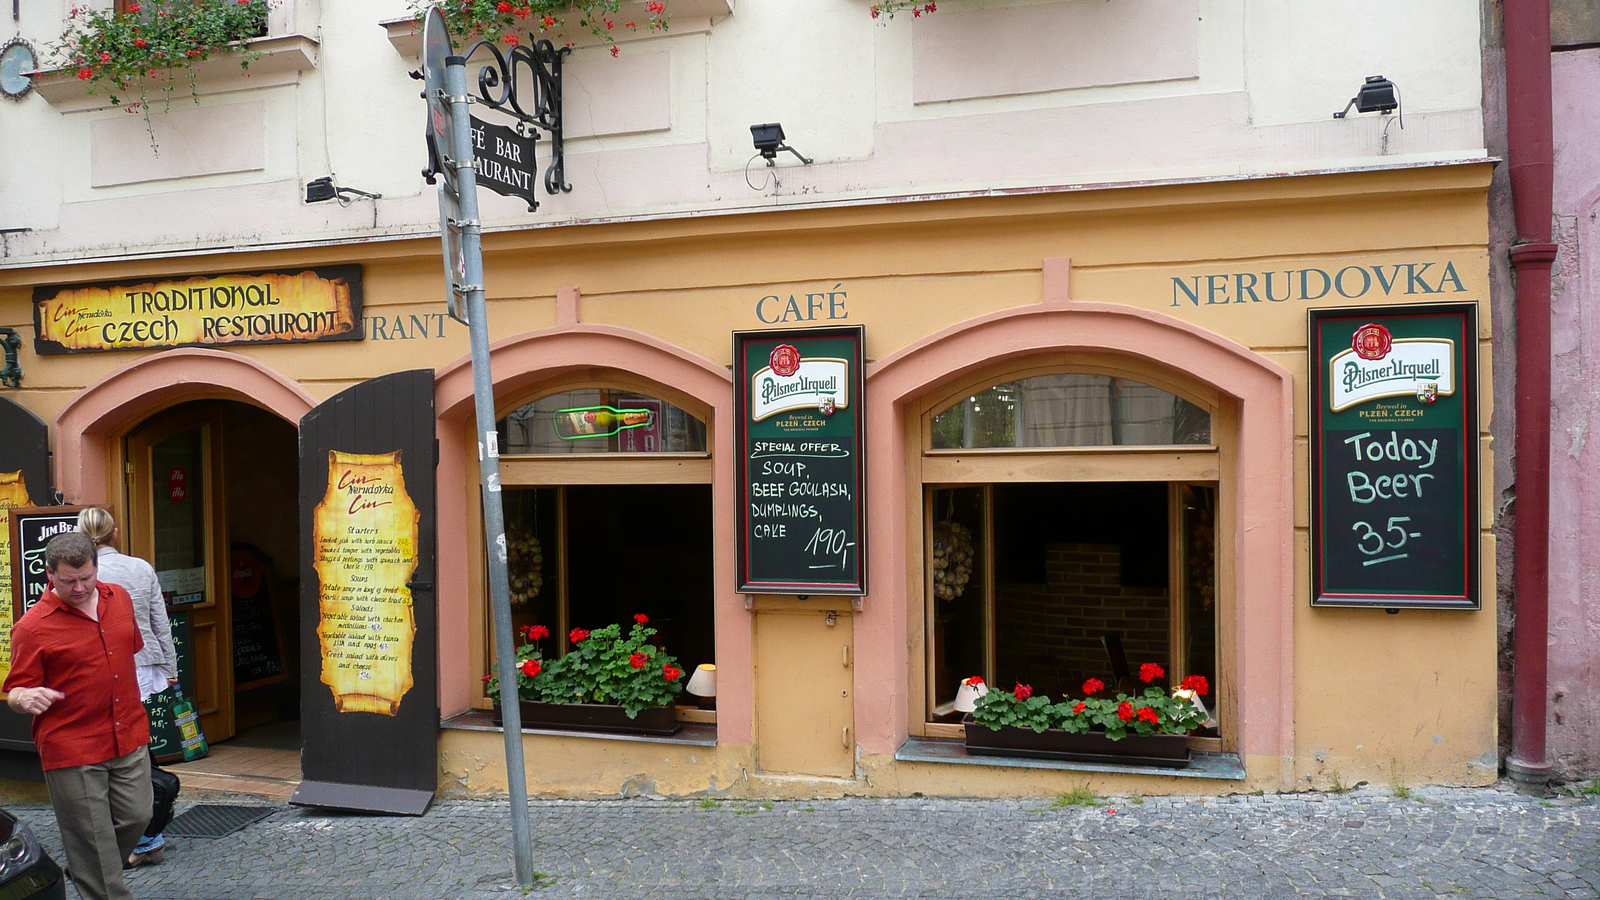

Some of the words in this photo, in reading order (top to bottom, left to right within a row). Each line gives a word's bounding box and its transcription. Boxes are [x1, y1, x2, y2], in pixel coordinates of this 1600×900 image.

[495, 136, 522, 164] BAR
[473, 155, 531, 190] AURANT
[1170, 260, 1468, 307] NERUDOVKA
[755, 283, 849, 324] CAFÉ
[1343, 361, 1393, 393] Pilsner
[1391, 358, 1440, 381] Urquell
[761, 377, 800, 405] Pilsner
[799, 375, 836, 396] Urquell
[1394, 409, 1424, 417] CZECH
[754, 441, 796, 452] SPECIAL
[800, 443, 841, 452] OFFER
[1344, 431, 1438, 468] Today
[171, 470, 184, 481] illy
[761, 461, 810, 479] SOUP,
[172, 486, 185, 499] illy
[752, 482, 785, 498] BEEF
[788, 482, 851, 501] GOULASH,
[1347, 471, 1435, 504] Beer
[751, 503, 822, 522] DUMPLINGS,
[37, 525, 58, 542] JIM
[58, 521, 80, 533] BEA
[347, 526, 379, 535] Starters
[753, 524, 787, 538] CAKE
[351, 604, 374, 612] Salads
[326, 650, 344, 658] Greek
[345, 652, 363, 660] salad
[365, 653, 379, 661] with
[380, 654, 398, 662] olives
